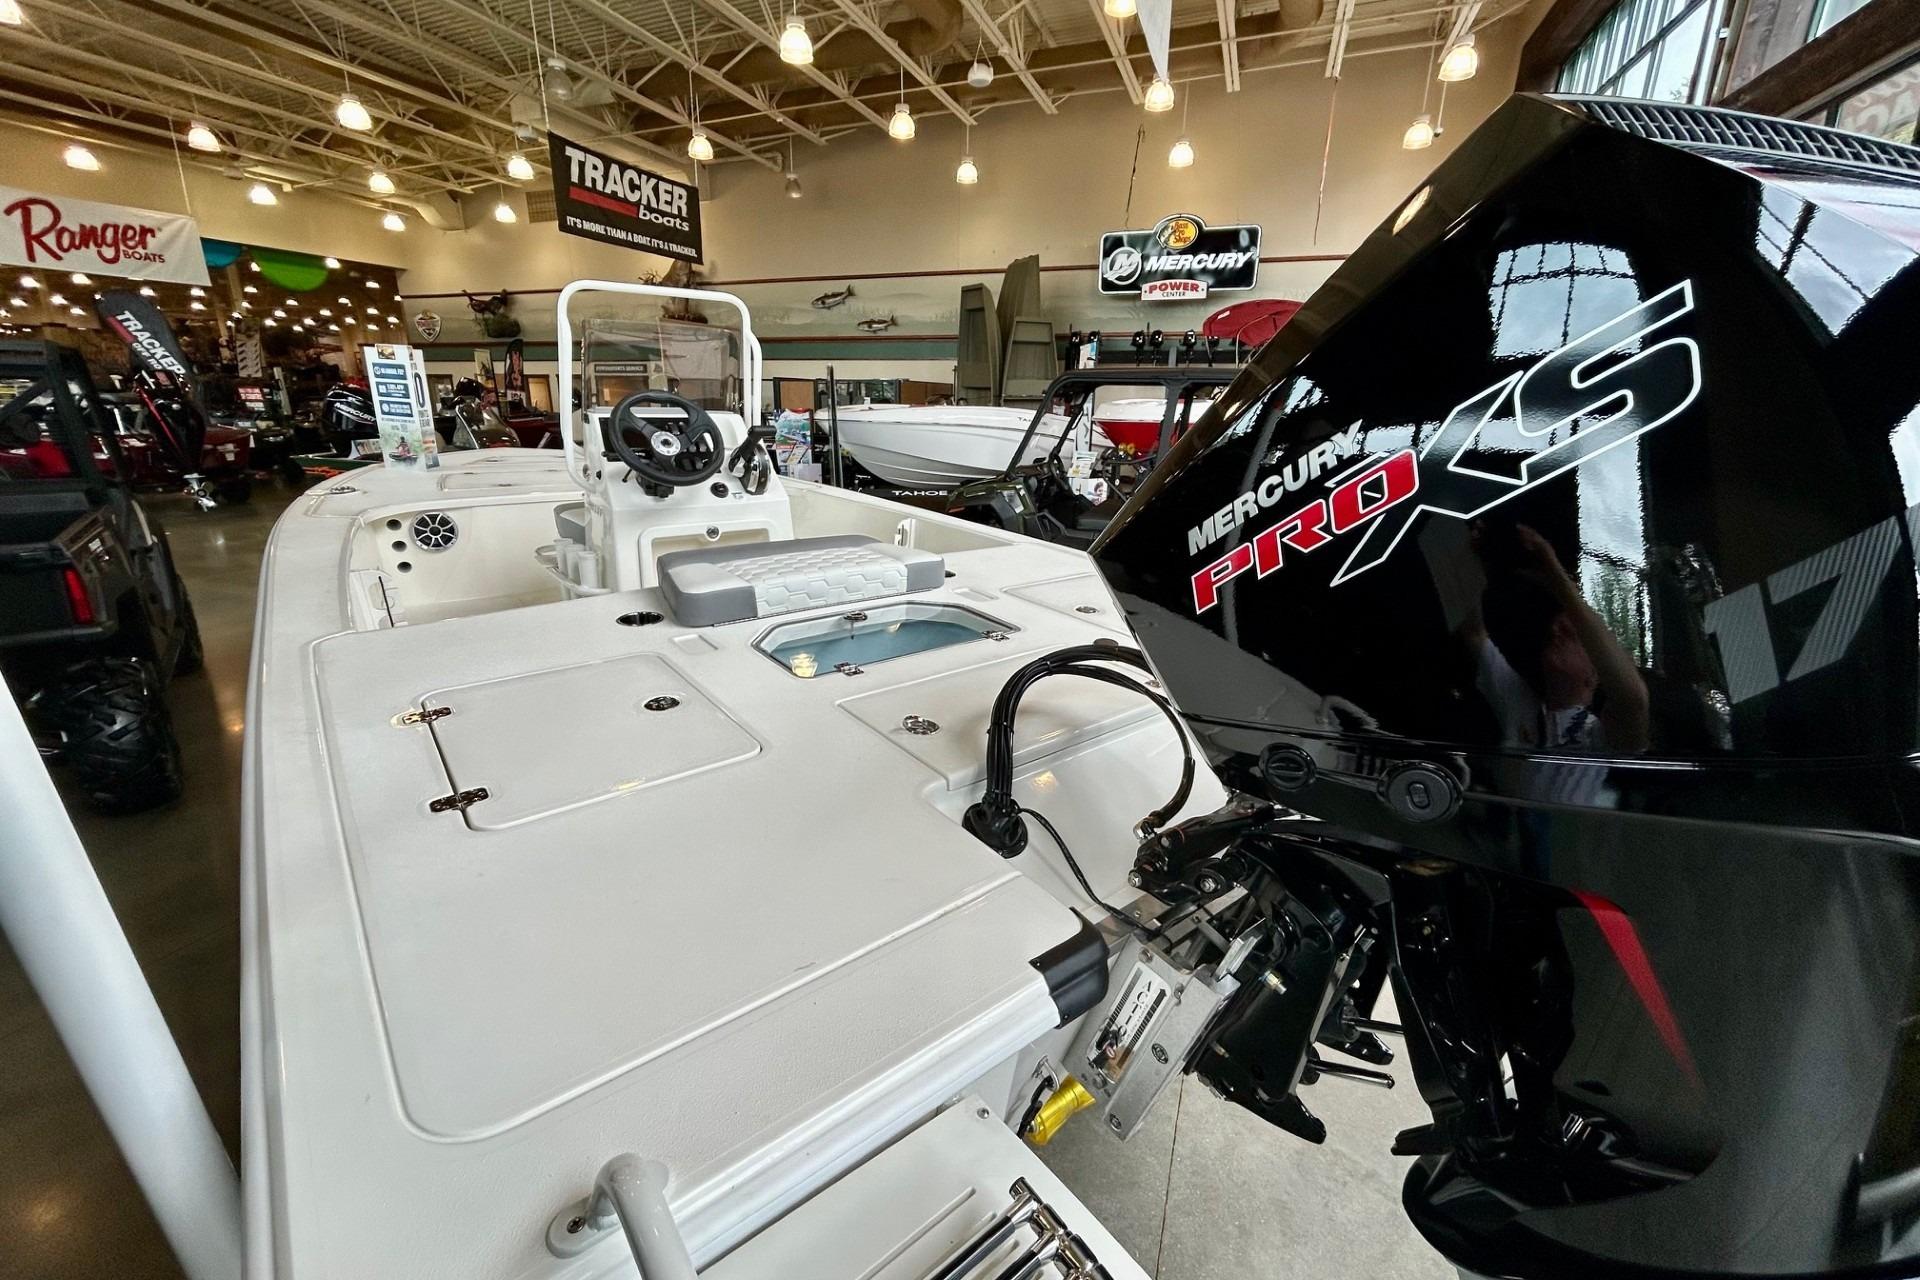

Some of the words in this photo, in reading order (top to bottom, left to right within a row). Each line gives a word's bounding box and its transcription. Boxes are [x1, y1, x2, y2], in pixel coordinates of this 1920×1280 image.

[565, 146, 689, 218] TRACKER
[3, 198, 156, 265] Ranger
[638, 204, 690, 231] boats
[582, 219, 606, 235] MORE
[605, 225, 627, 240] THAN
[627, 231, 633, 242] A
[663, 241, 669, 251] A
[123, 249, 166, 263] BOATS
[1146, 251, 1254, 273] MERCURY
[1148, 281, 1200, 295] POWER
[1161, 290, 1186, 298] CENTER
[1330, 279, 1702, 588] XS
[891, 489, 949, 497] TAHOE
[1187, 418, 1365, 557] MERCURY
[1190, 448, 1419, 616] PRO
